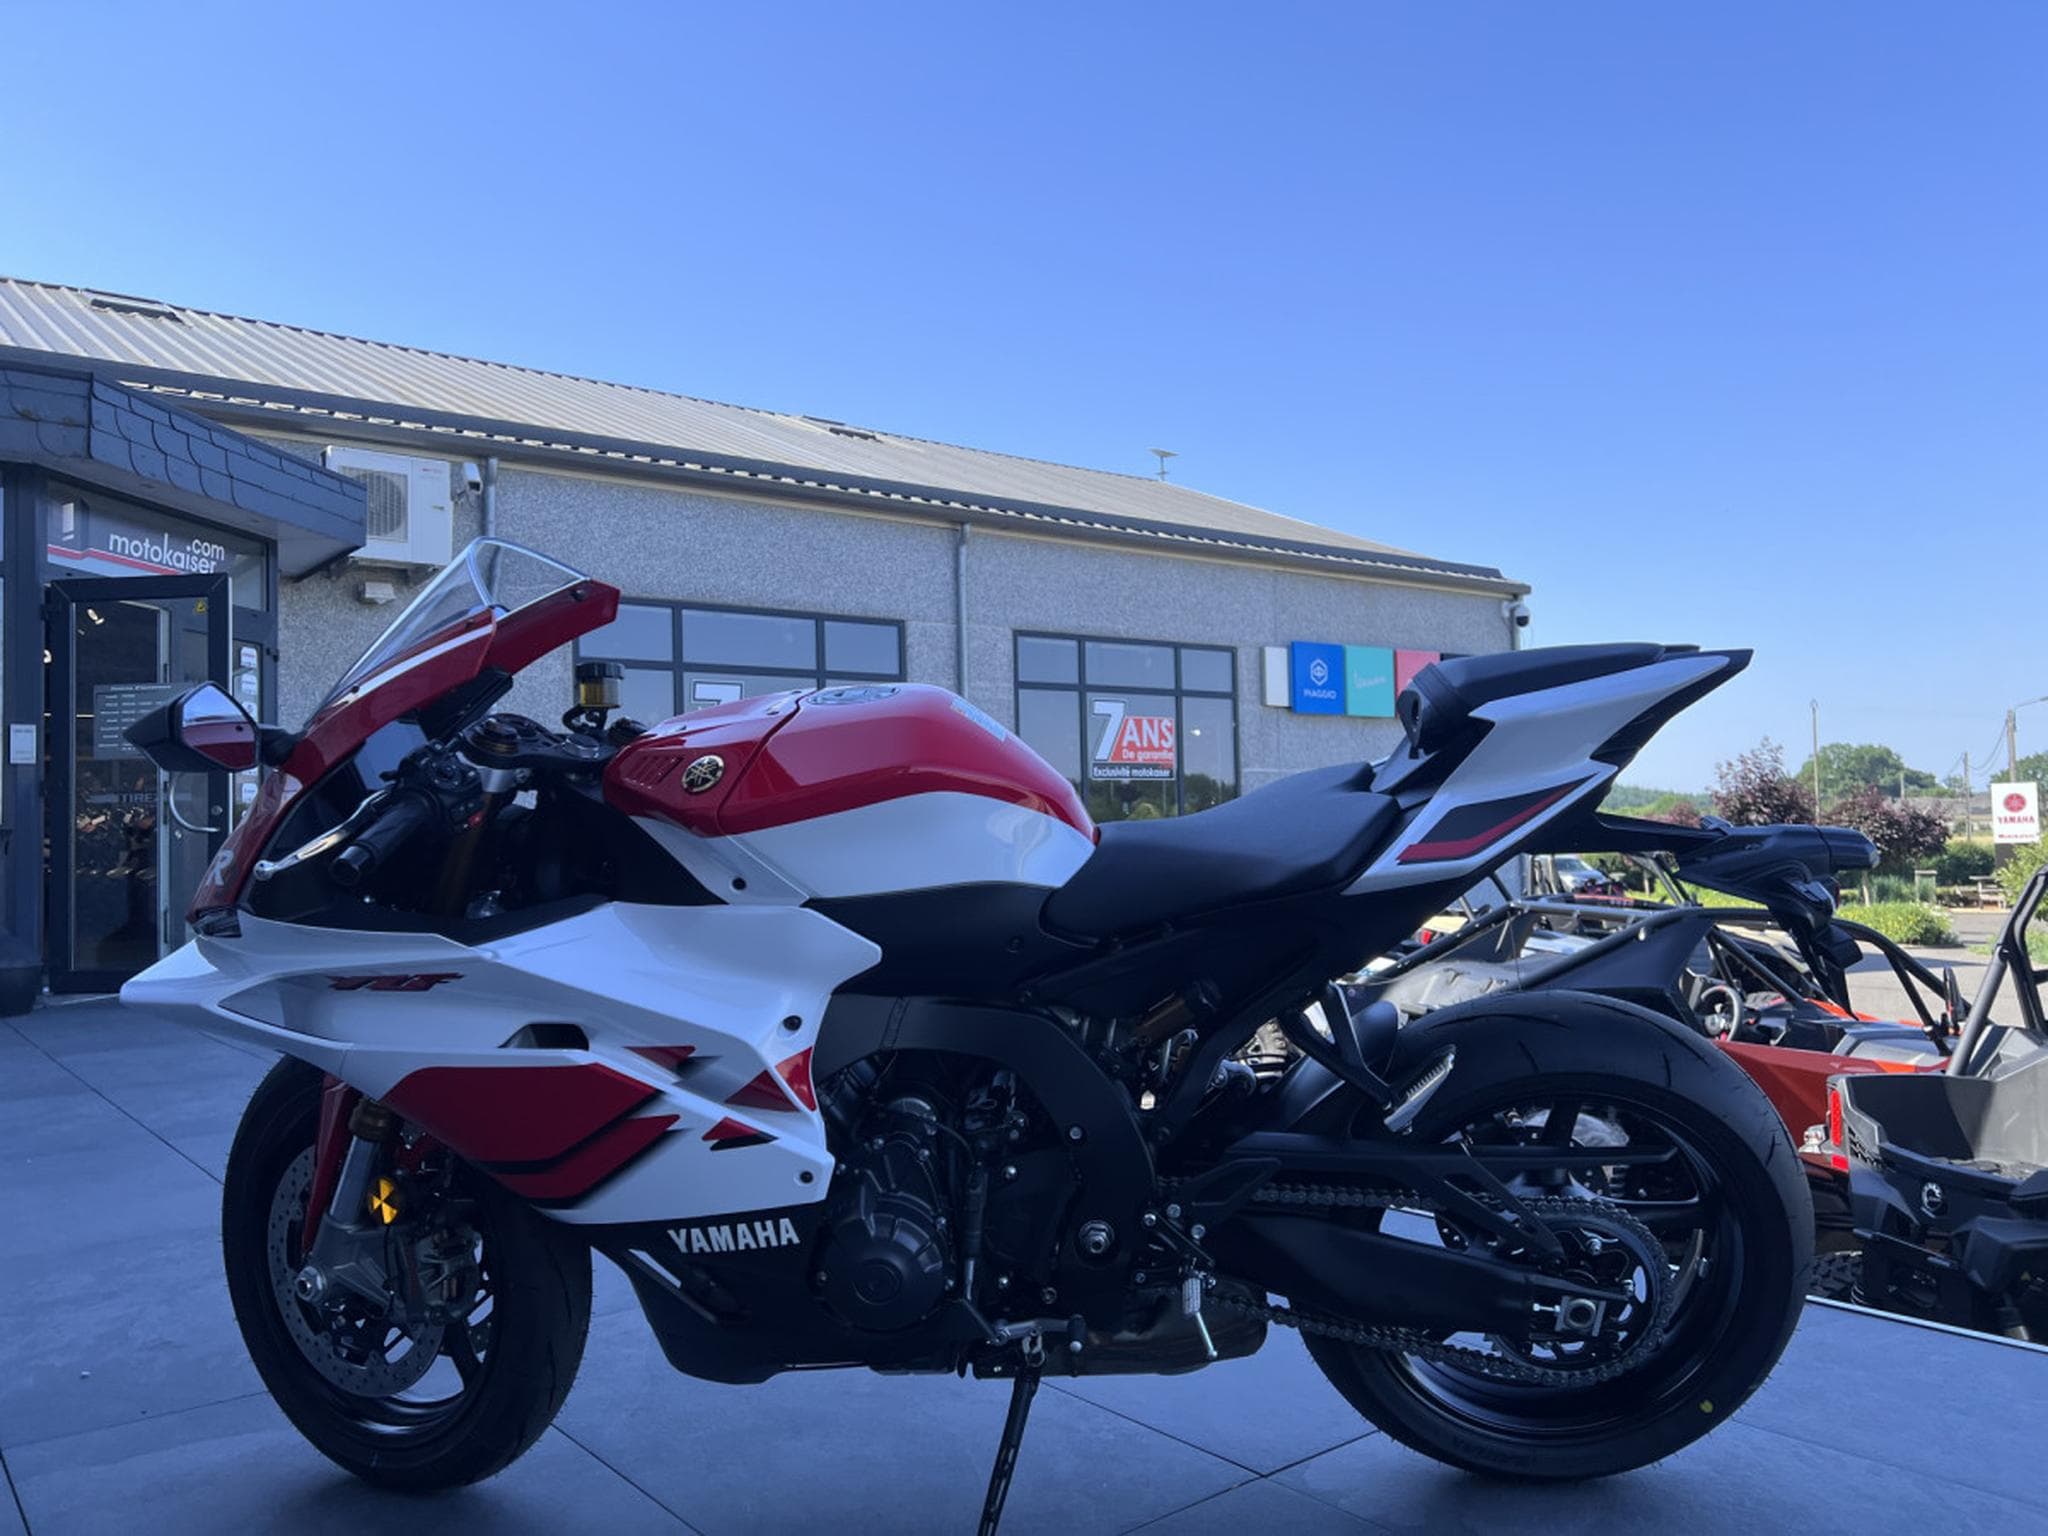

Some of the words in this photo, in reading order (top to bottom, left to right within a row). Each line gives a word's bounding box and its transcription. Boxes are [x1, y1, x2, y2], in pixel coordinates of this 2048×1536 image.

[109, 533, 217, 573] motokaiser
[186, 537, 225, 561] .com
[1092, 699, 1126, 761] 7
[1122, 718, 1174, 748] ANS
[1997, 815, 2035, 825] YAMAHA
[667, 1217, 801, 1254] YAMAHA
